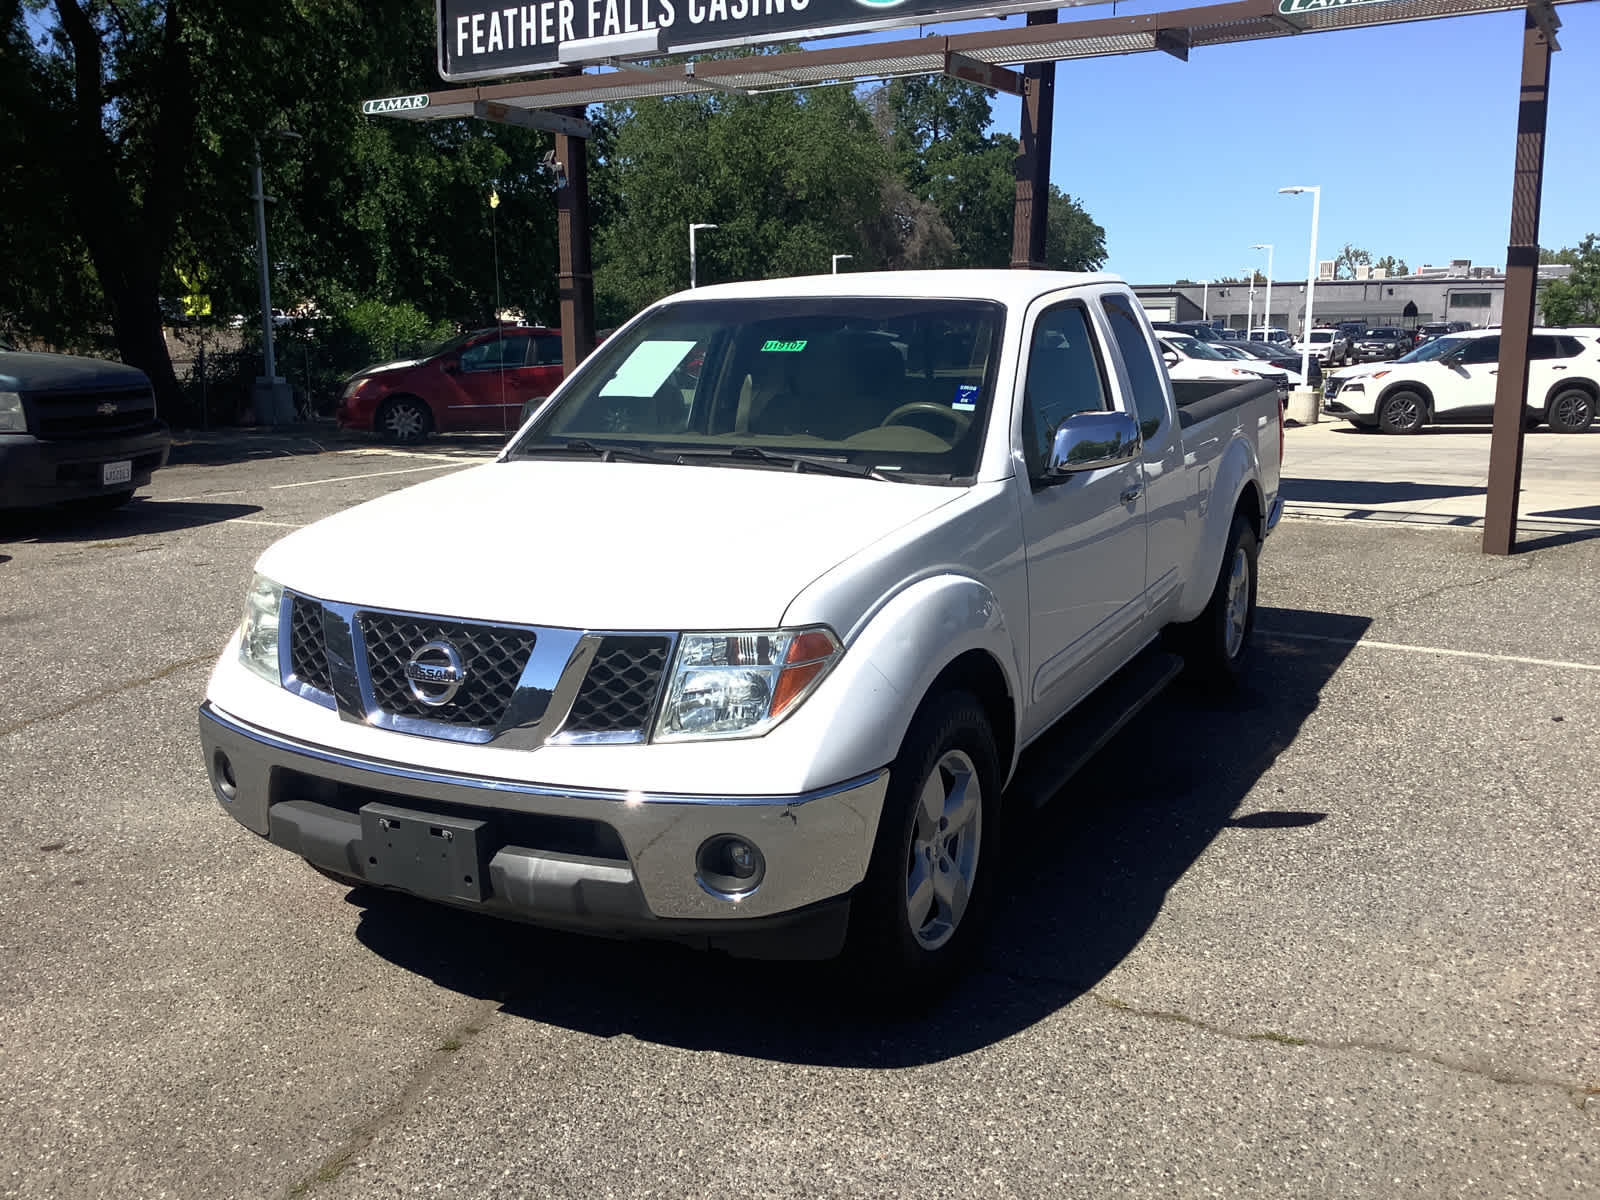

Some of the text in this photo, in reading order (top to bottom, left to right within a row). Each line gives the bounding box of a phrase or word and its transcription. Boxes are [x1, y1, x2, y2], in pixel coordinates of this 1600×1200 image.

[457, 0, 810, 56] FEATHER FALLS CAS
[369, 96, 423, 112] LAMAR
[408, 664, 457, 681] NISSAN
